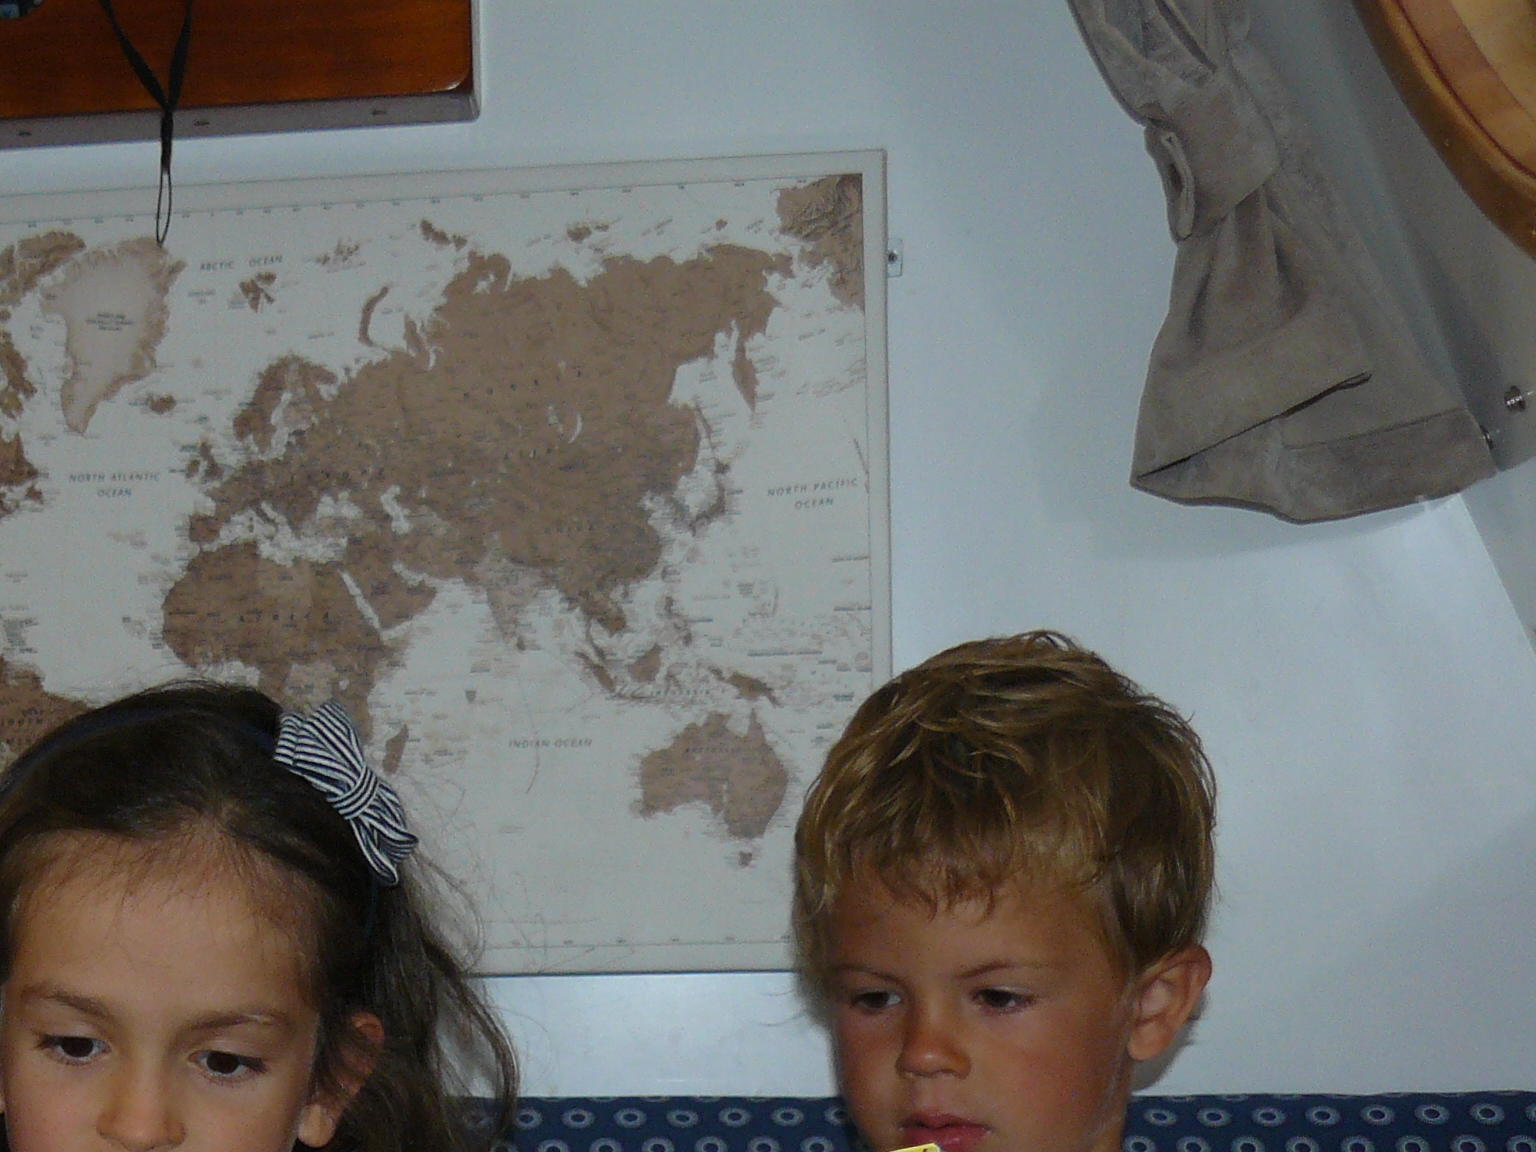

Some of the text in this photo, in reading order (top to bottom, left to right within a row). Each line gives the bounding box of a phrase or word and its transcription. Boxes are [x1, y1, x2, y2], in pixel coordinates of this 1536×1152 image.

[200, 256, 283, 271] ARCTIC OCEAN
[69, 472, 161, 483] NORTH ATLANTIC
[97, 488, 132, 498] OCEAN
[768, 478, 858, 497] NORTH PACIFIC
[794, 497, 834, 510] OCEAN
[508, 738, 593, 748] INDIAN OCEAN
